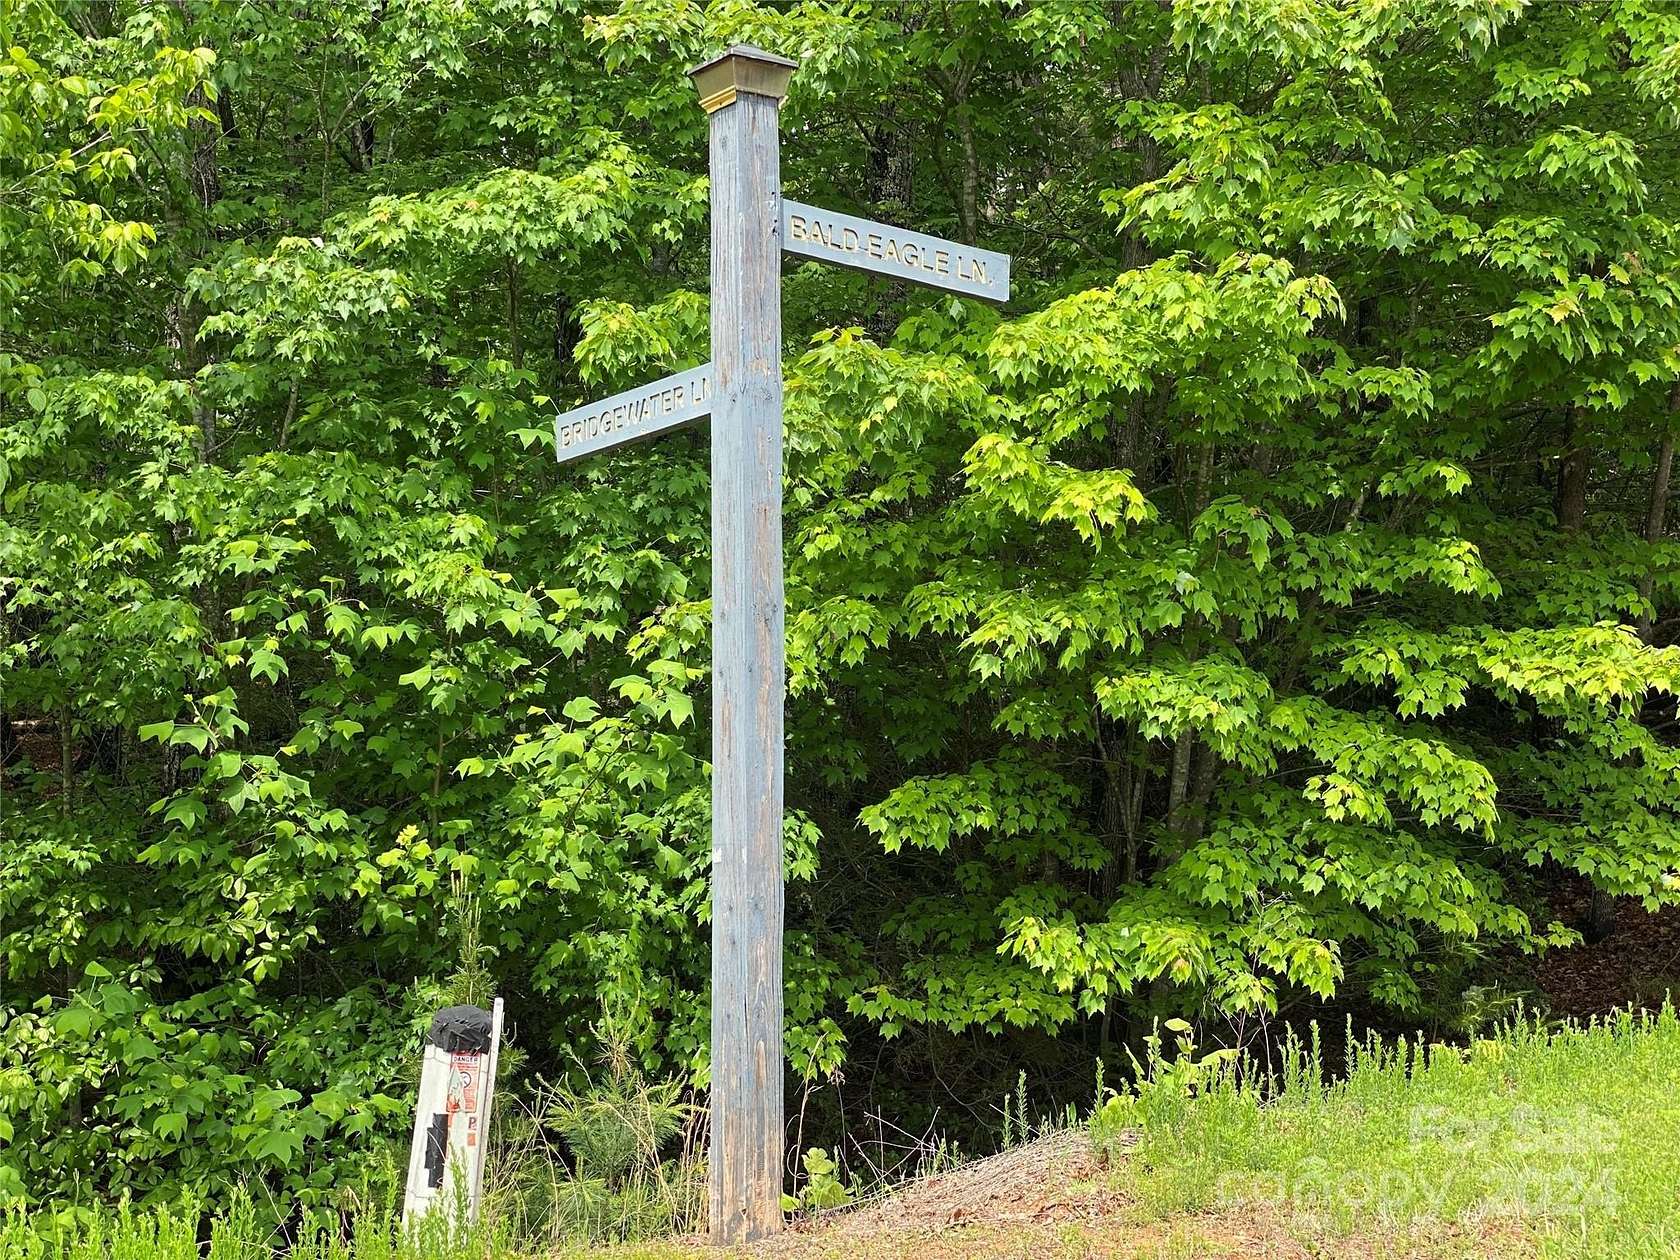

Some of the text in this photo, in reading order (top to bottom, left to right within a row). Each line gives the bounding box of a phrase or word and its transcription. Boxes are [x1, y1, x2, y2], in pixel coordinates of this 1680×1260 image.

[791, 215, 993, 286] BALD EAGLE LN.
[560, 385, 685, 449] BRIDGEWATER
